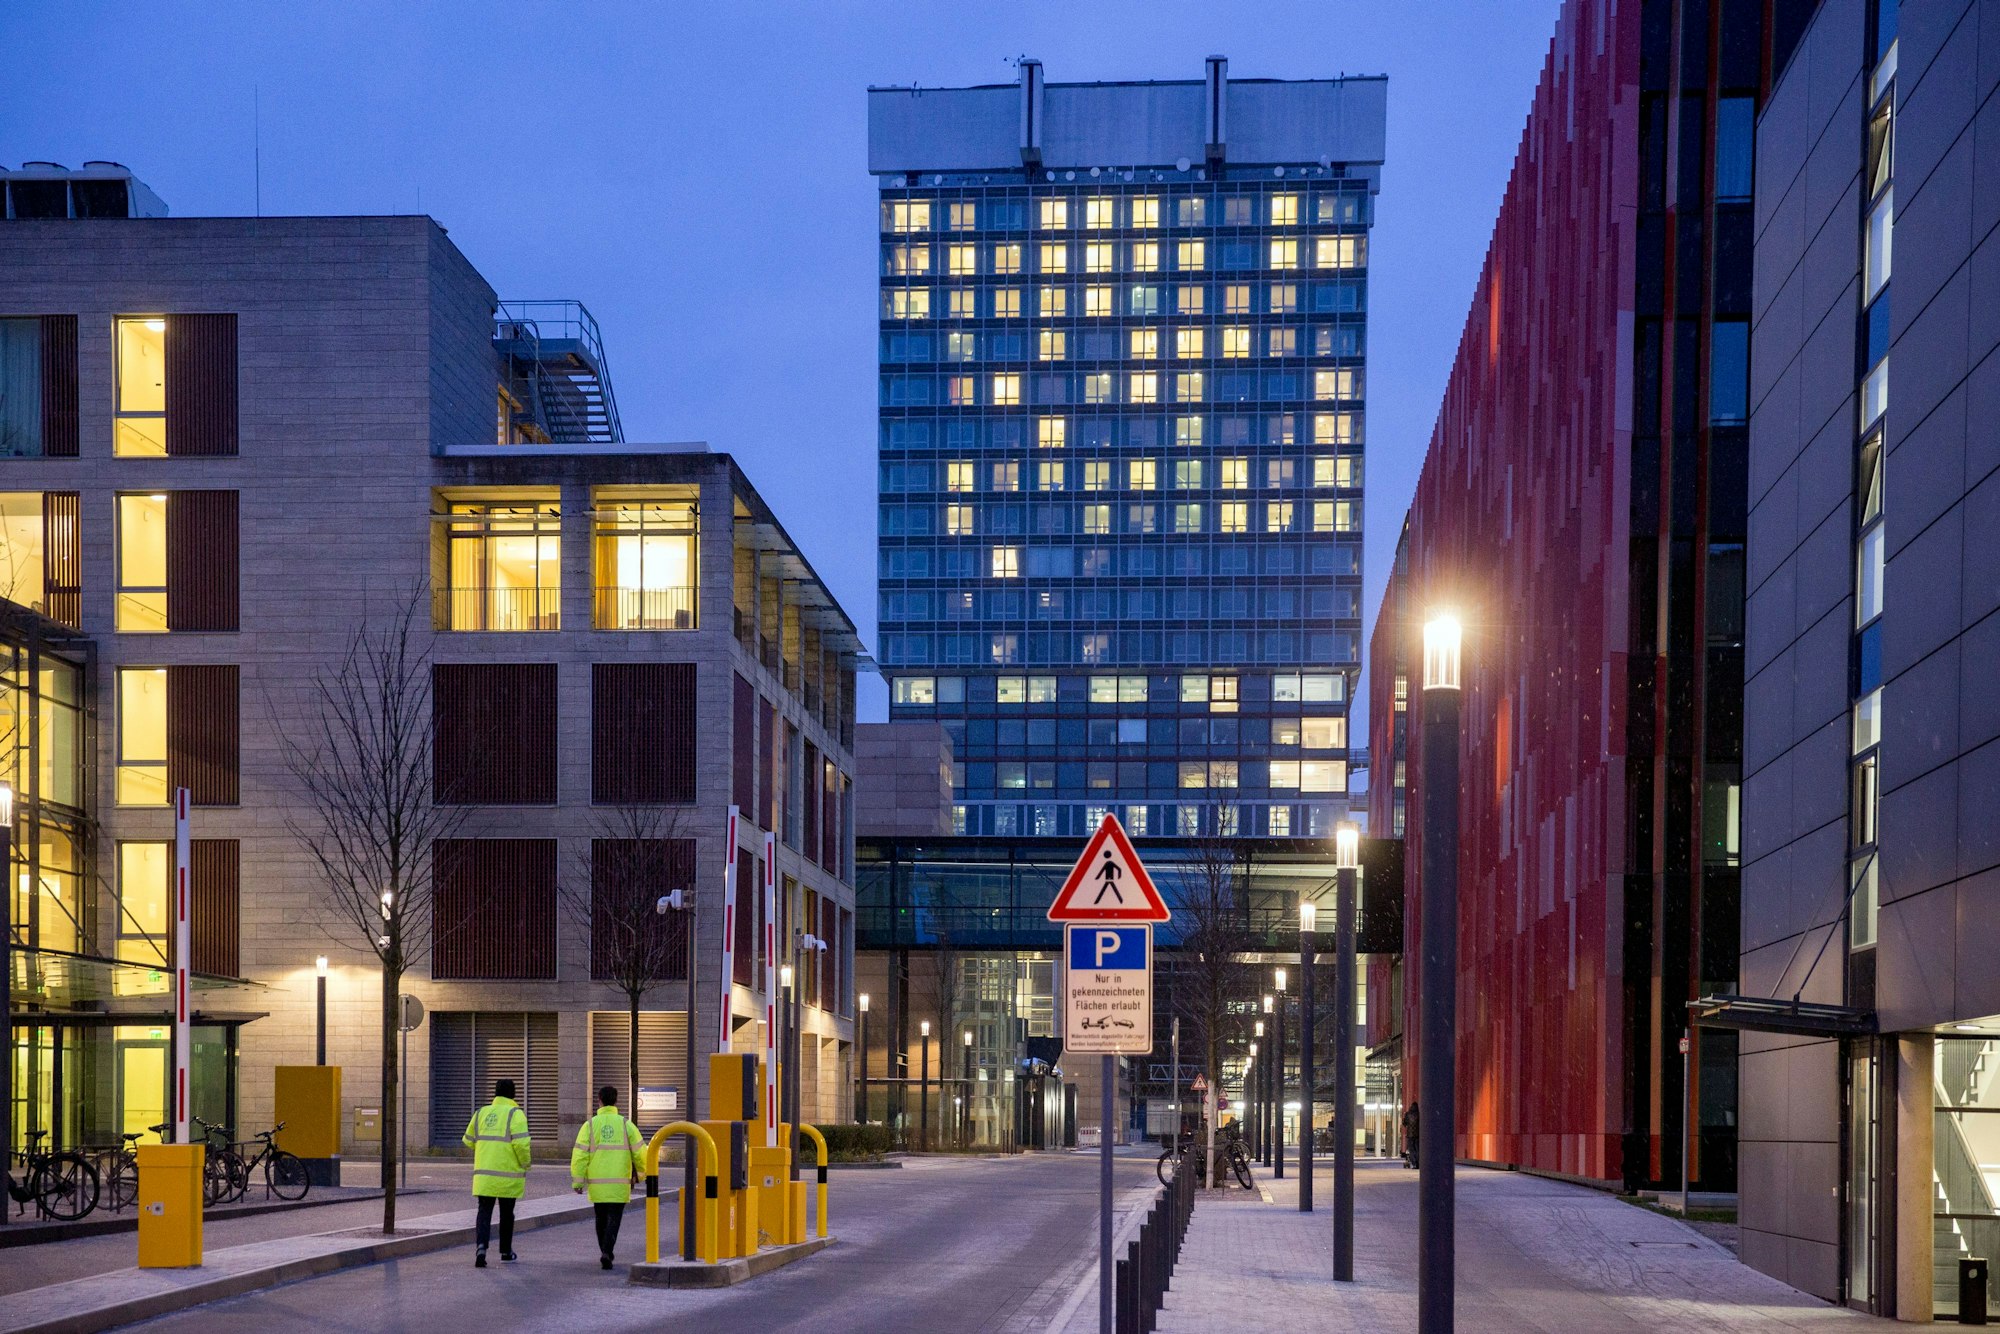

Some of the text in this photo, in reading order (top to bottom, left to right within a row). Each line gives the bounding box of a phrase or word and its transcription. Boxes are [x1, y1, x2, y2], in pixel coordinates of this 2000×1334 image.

[1096, 931, 1121, 967] P
[1095, 974, 1122, 983] Nur in
[1072, 987, 1145, 998] gekennzeichneten
[1076, 1000, 1141, 1010] Flächen erlaubt
